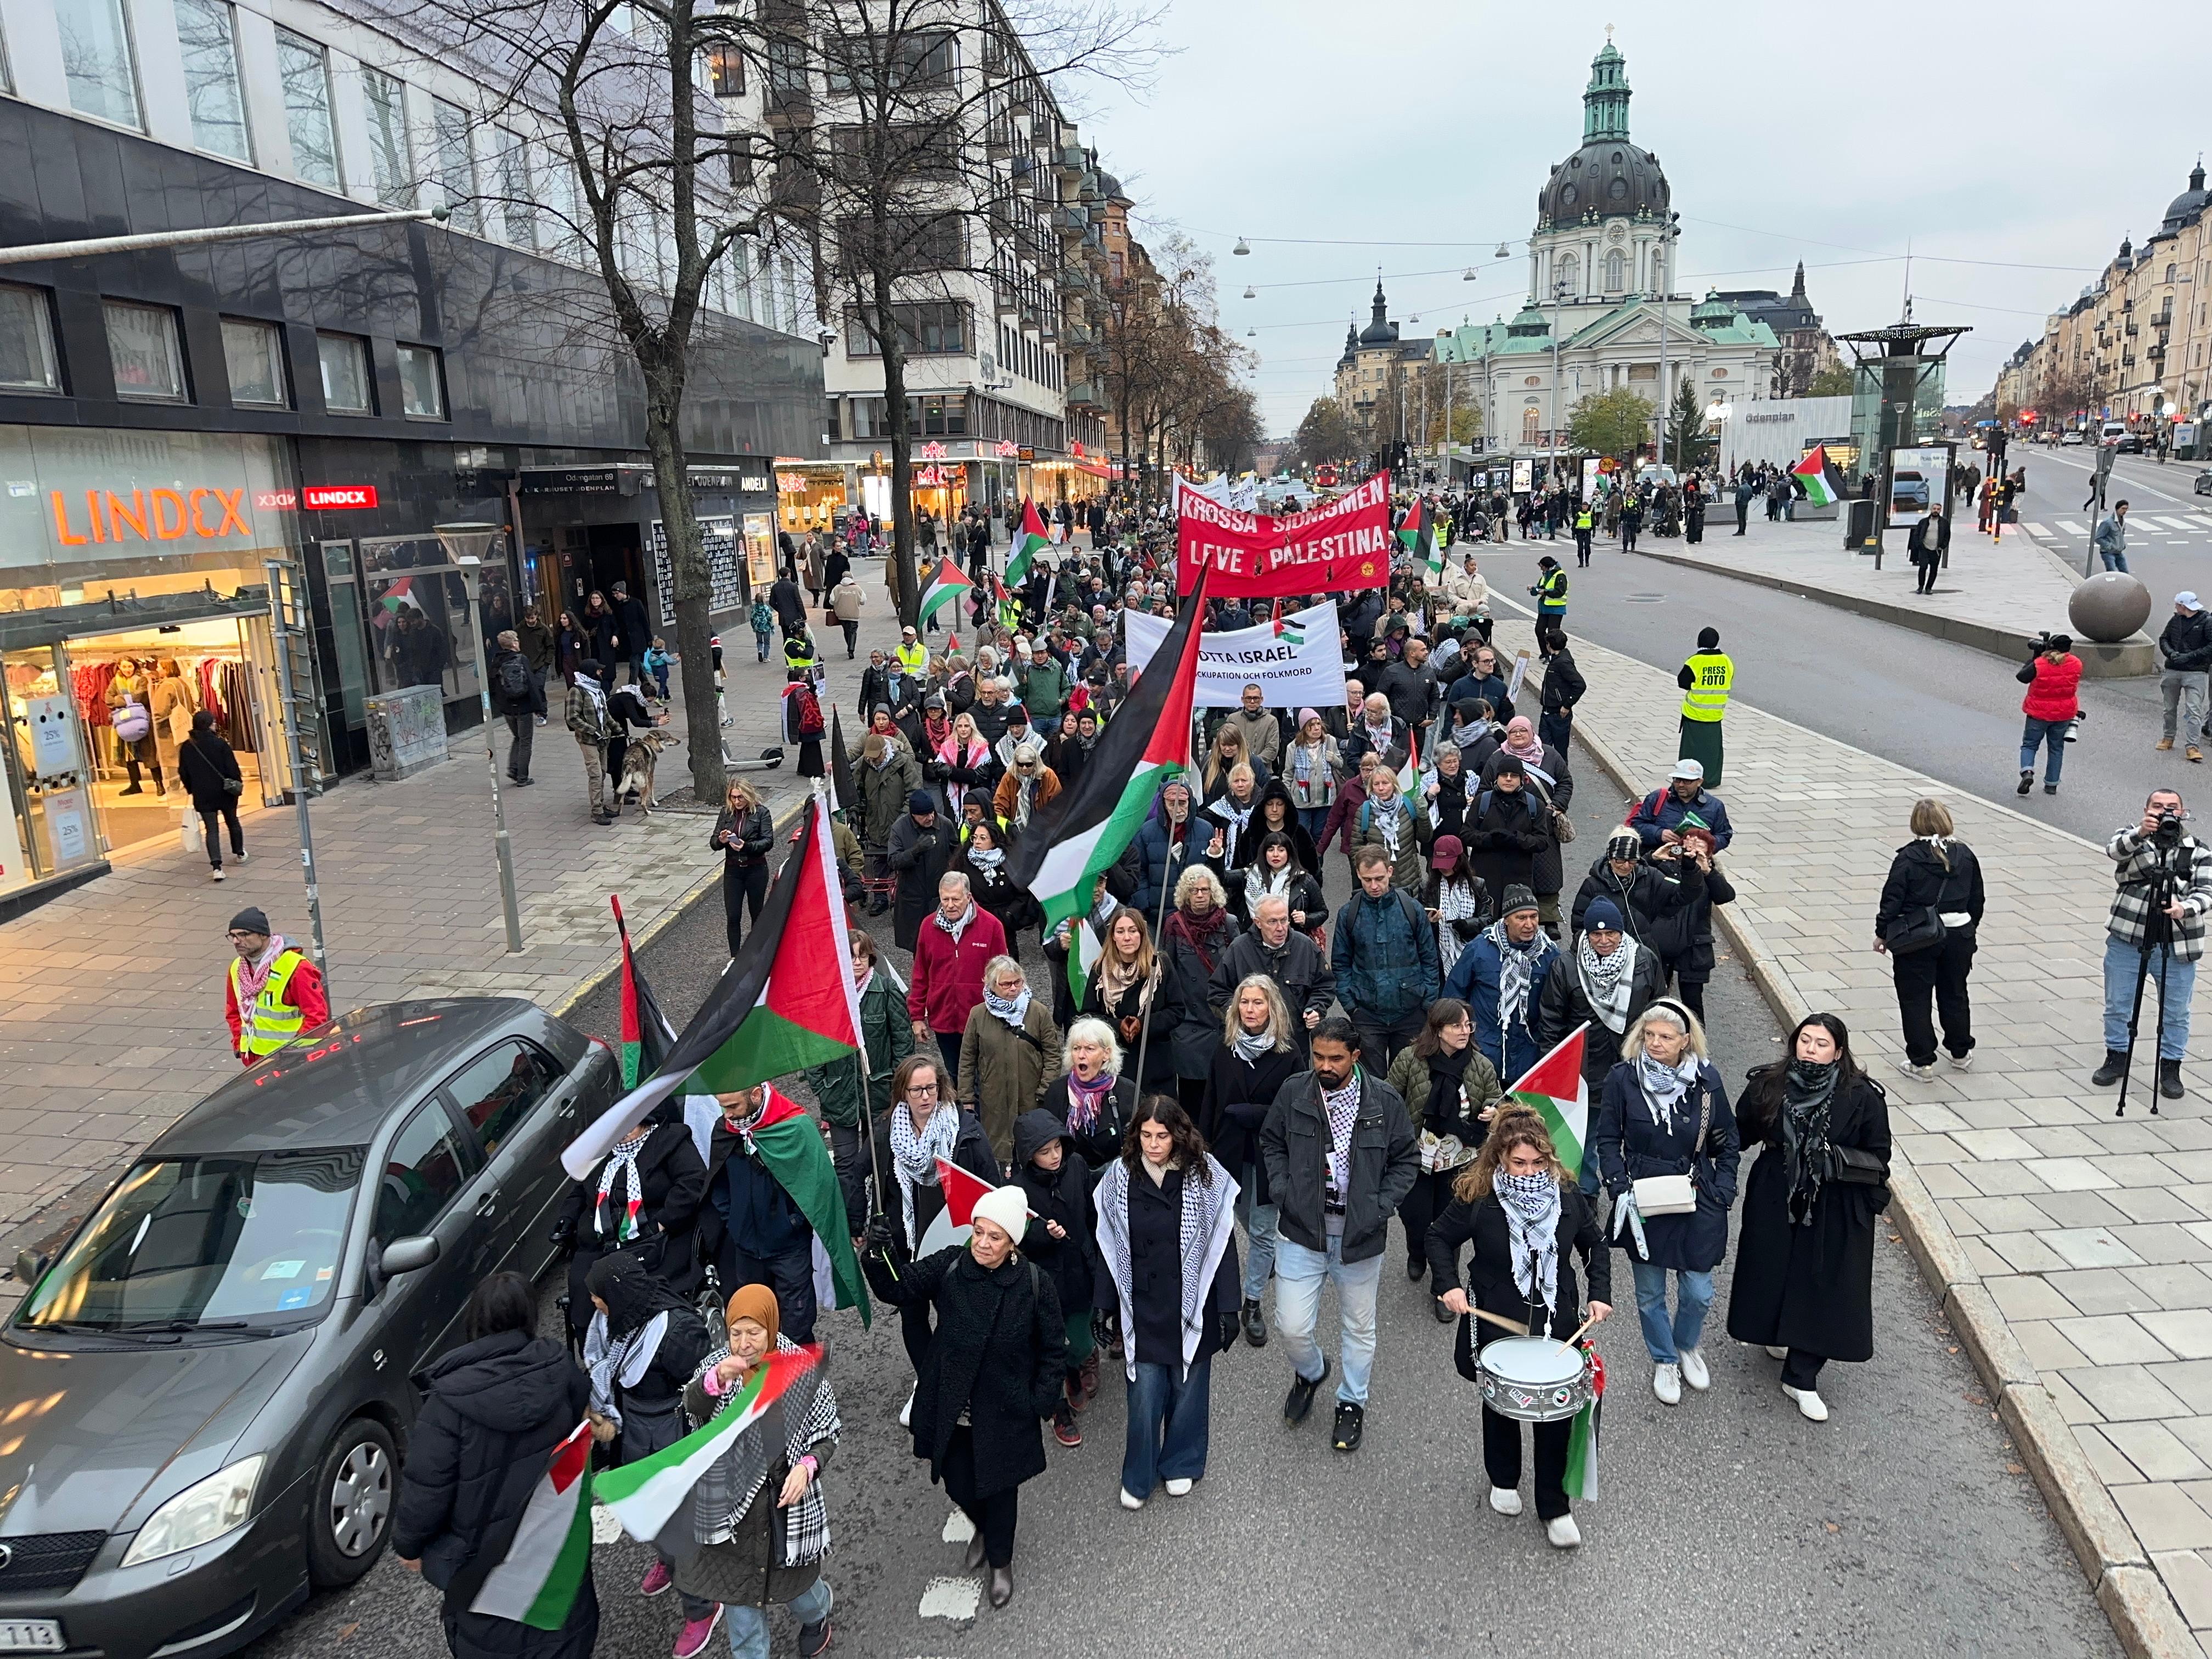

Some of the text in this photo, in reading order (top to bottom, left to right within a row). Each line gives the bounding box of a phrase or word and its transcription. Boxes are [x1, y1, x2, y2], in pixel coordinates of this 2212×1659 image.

[1746, 411, 1795, 423] Odenplan
[922, 441, 947, 458] MAX
[995, 440, 1019, 456] MAX
[777, 472, 806, 492] MAX
[310, 492, 365, 505] LINDEX
[1181, 477, 1384, 533] KROSSA SIONISMEN
[50, 488, 250, 545] LINDEX
[1190, 525, 1386, 573] LEVE PALESTINA
[1239, 645, 1298, 664] ISRAEL
[1243, 671, 1261, 680] OCH
[1262, 667, 1312, 679] FOLKMORD
[1702, 666, 1726, 675] PRESS
[1701, 675, 1725, 686] FOTO
[43, 729, 61, 741] 25%
[62, 825, 78, 836] 25%
[1511, 1389, 1527, 1402] FREE
